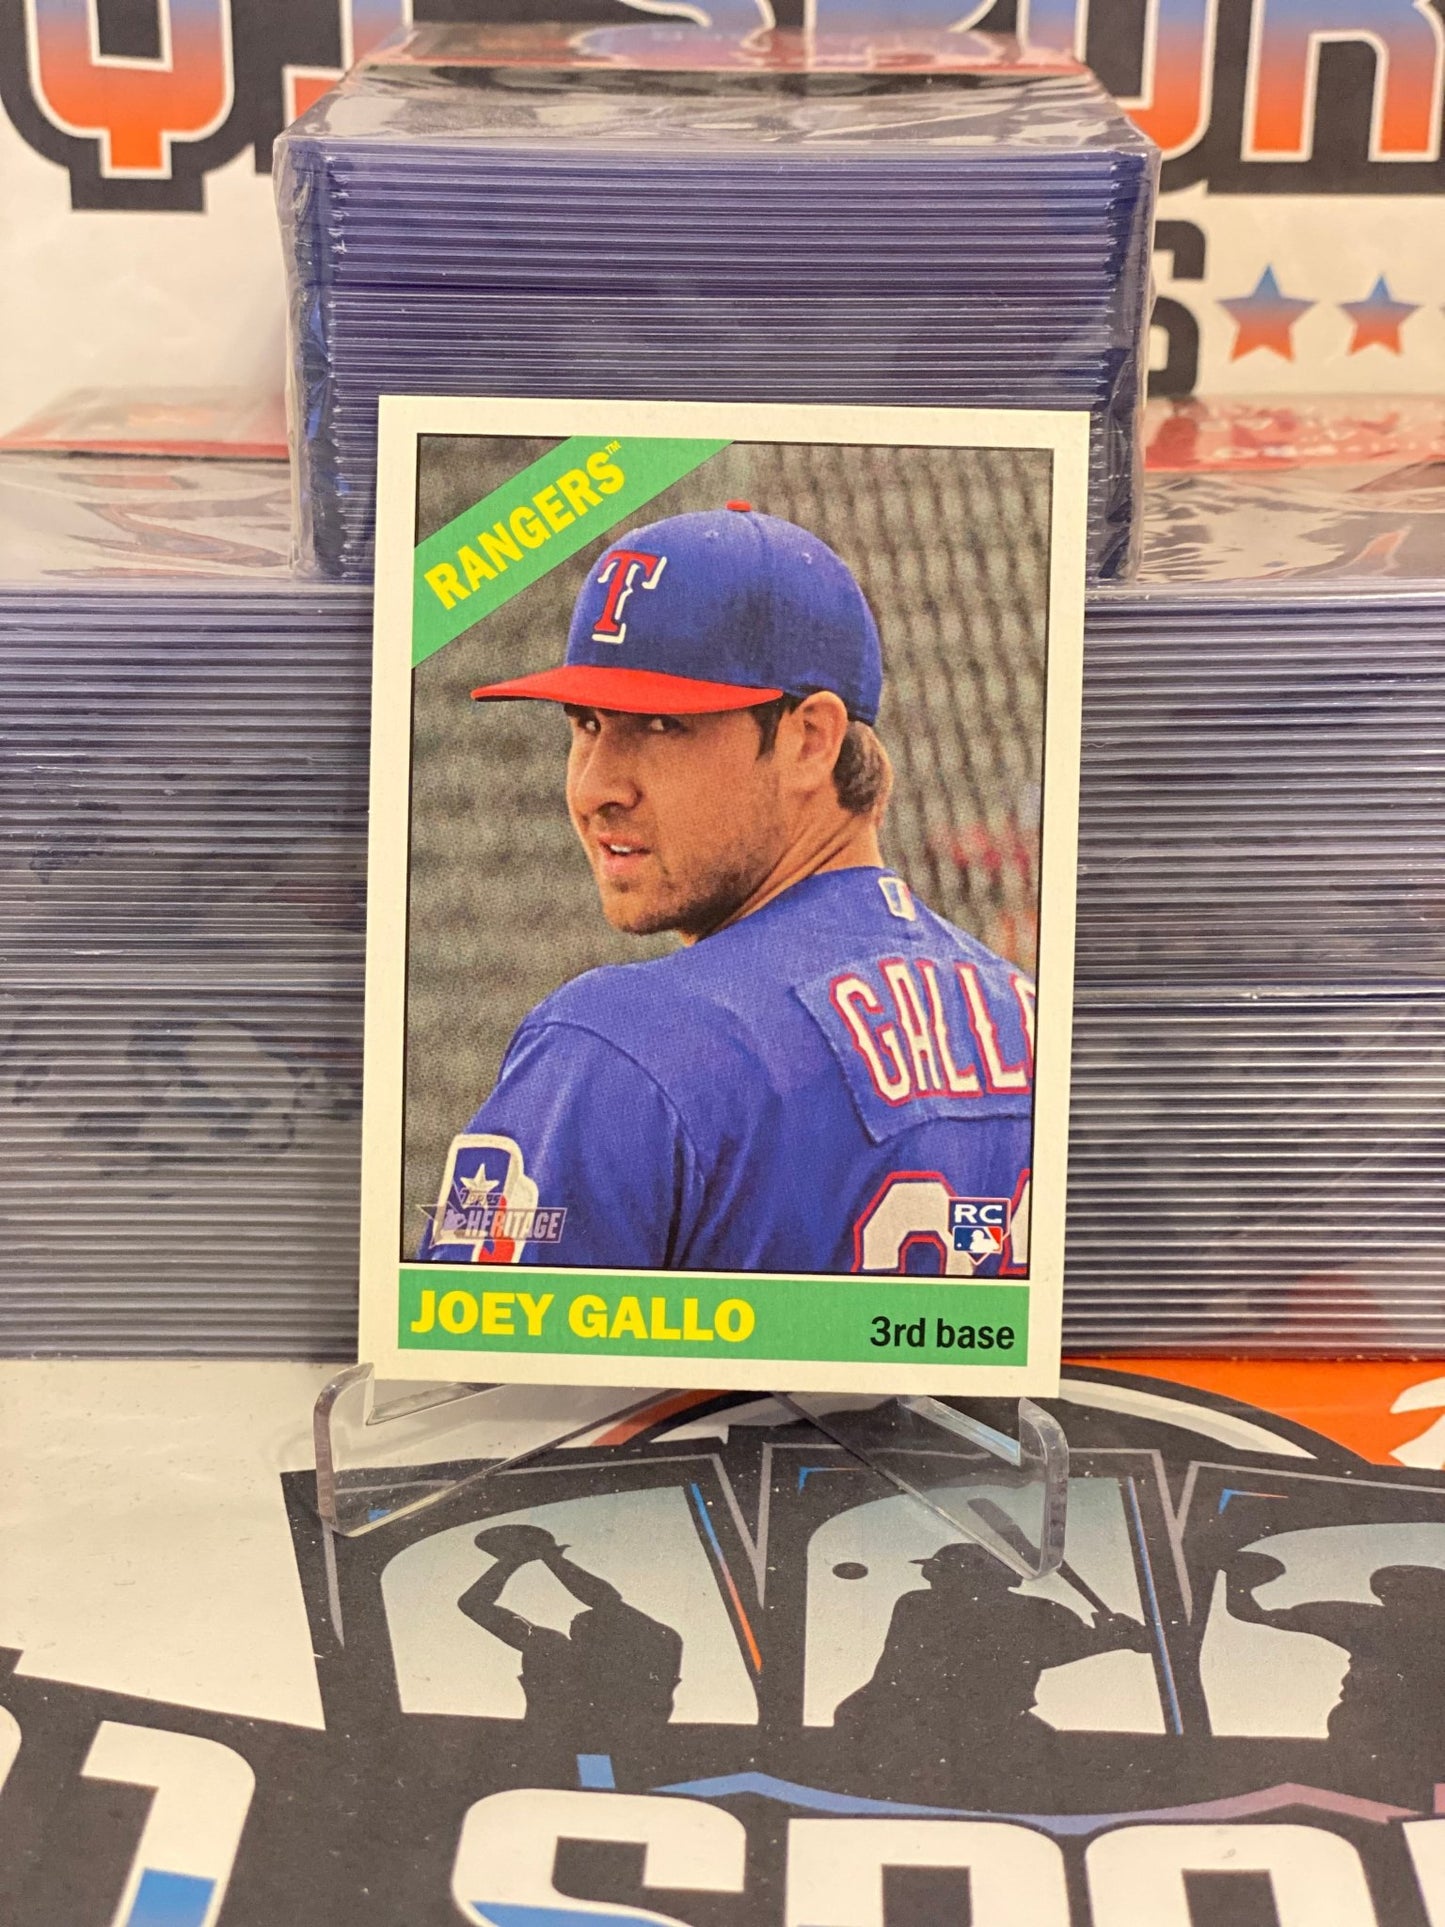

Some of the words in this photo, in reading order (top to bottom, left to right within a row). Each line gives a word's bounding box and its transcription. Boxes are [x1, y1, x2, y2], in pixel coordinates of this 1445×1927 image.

[424, 450, 625, 610] RANGERS
[592, 549, 667, 644] T
[465, 1209, 562, 1240] HERITAGE
[954, 1203, 1003, 1224] RC
[410, 1290, 555, 1336] JOEY
[568, 1295, 756, 1342] GALLO
[870, 1316, 926, 1348] 3rd
[936, 1318, 1015, 1350] base
